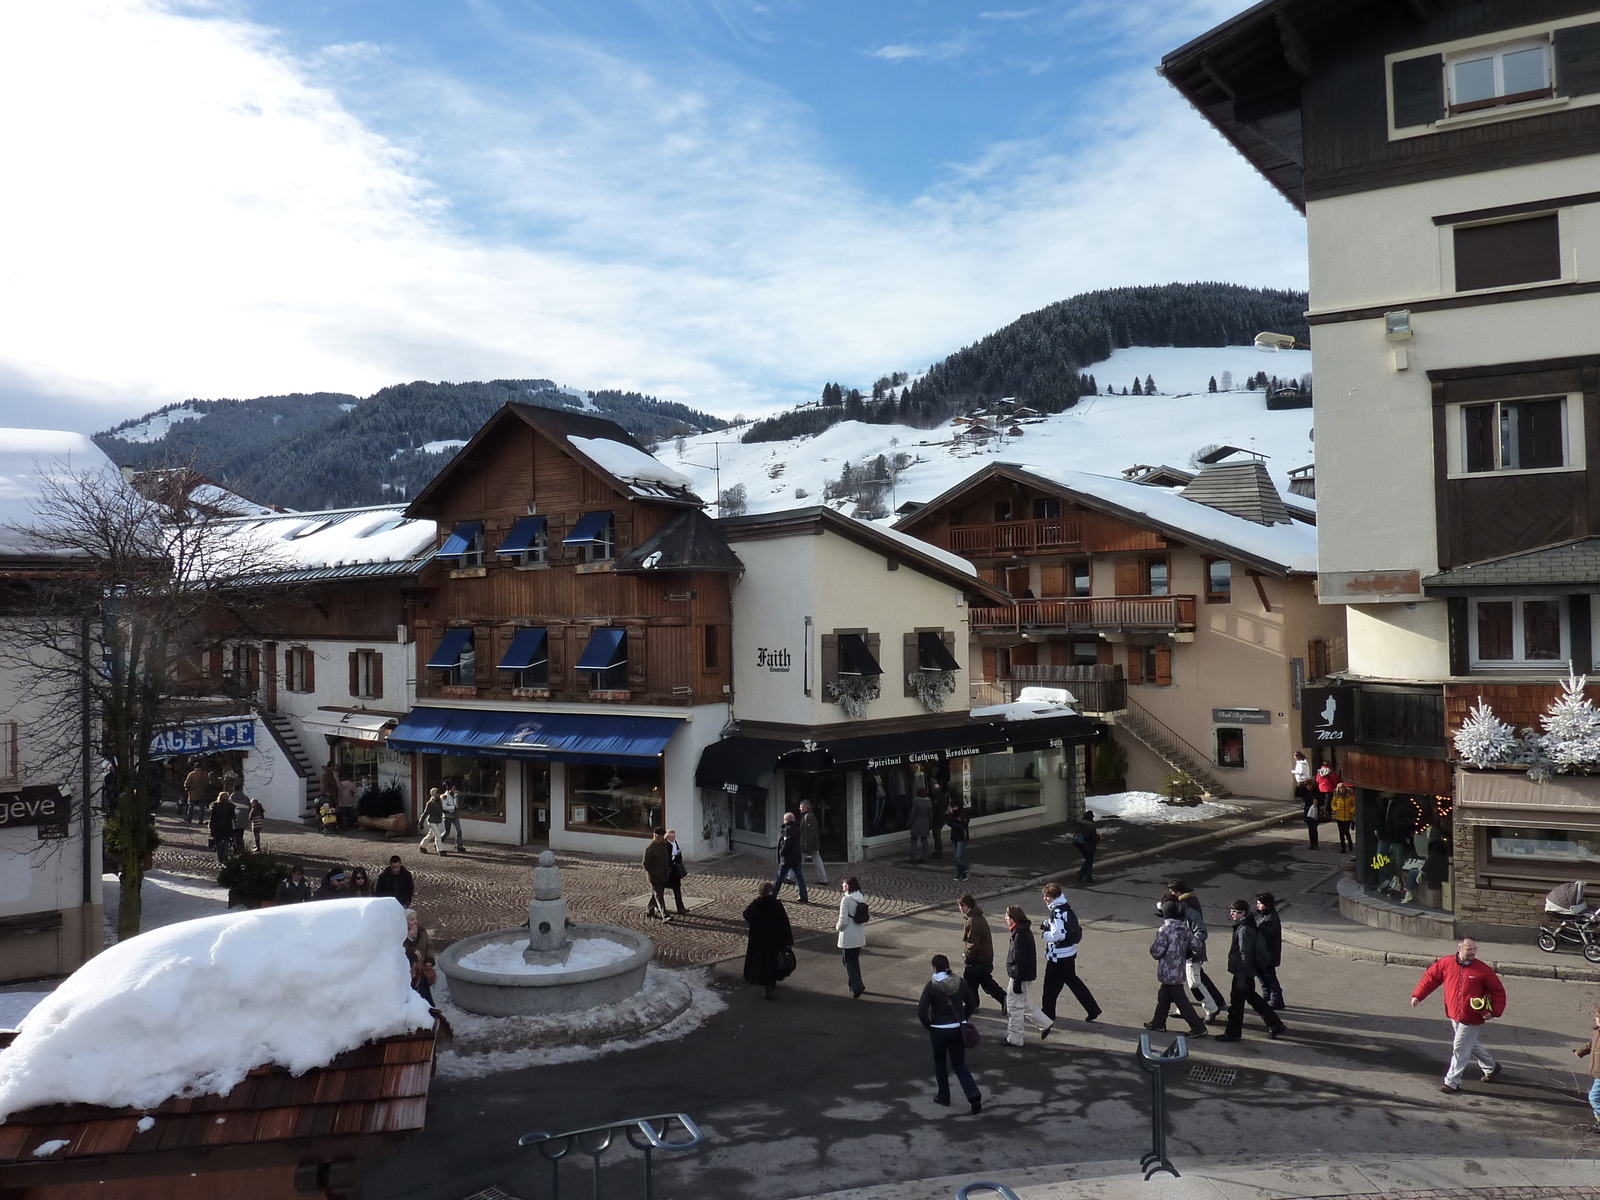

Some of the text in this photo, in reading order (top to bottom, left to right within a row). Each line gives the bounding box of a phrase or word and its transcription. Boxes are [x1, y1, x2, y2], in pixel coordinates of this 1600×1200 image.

[757, 648, 791, 667] Faith
[1218, 711, 1265, 721] Peak Performance
[867, 747, 980, 769] Spiritual Clothing Revolution
[1370, 853, 1390, 869] -40%
